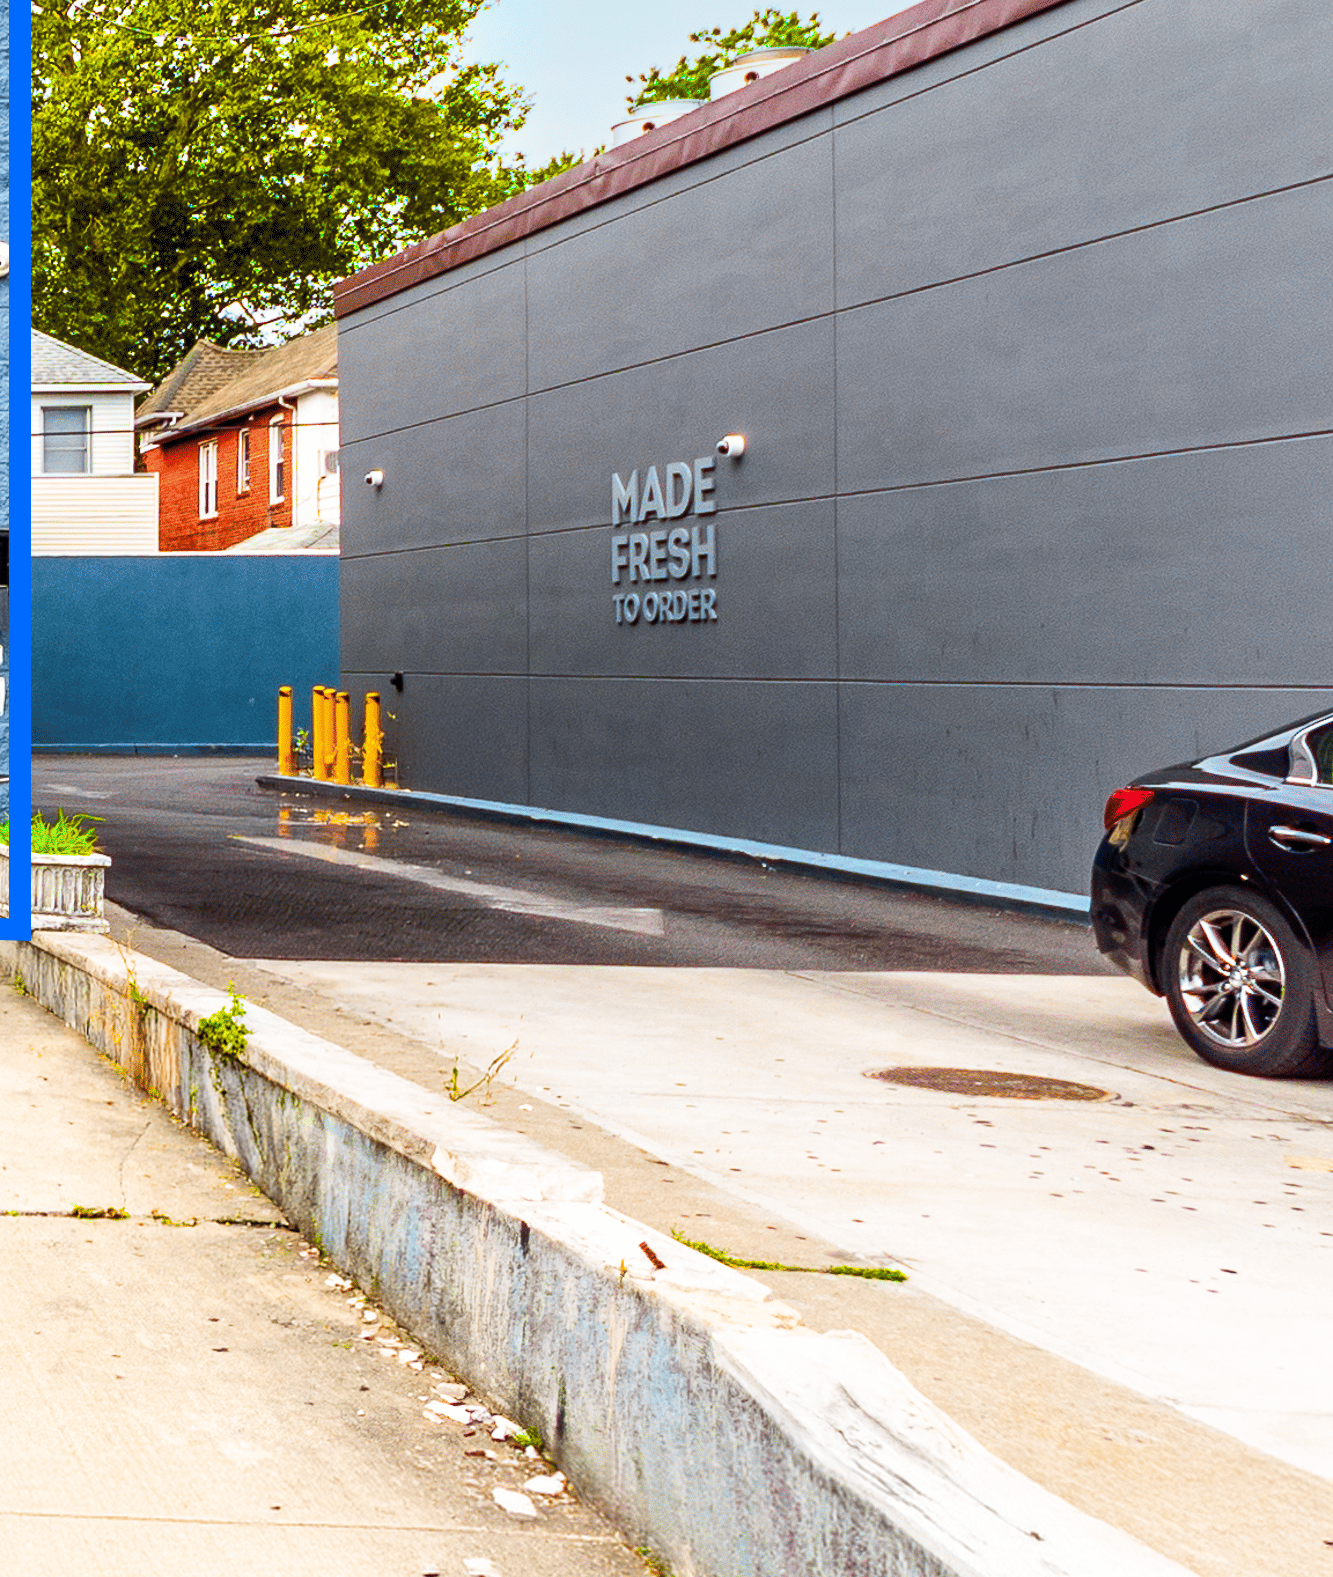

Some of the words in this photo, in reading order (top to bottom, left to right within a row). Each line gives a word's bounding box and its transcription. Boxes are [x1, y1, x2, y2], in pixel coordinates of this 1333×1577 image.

[611, 456, 717, 526] MADE
[611, 525, 718, 584] FRESH
[612, 592, 641, 624] TO
[642, 587, 719, 624] ORDER
